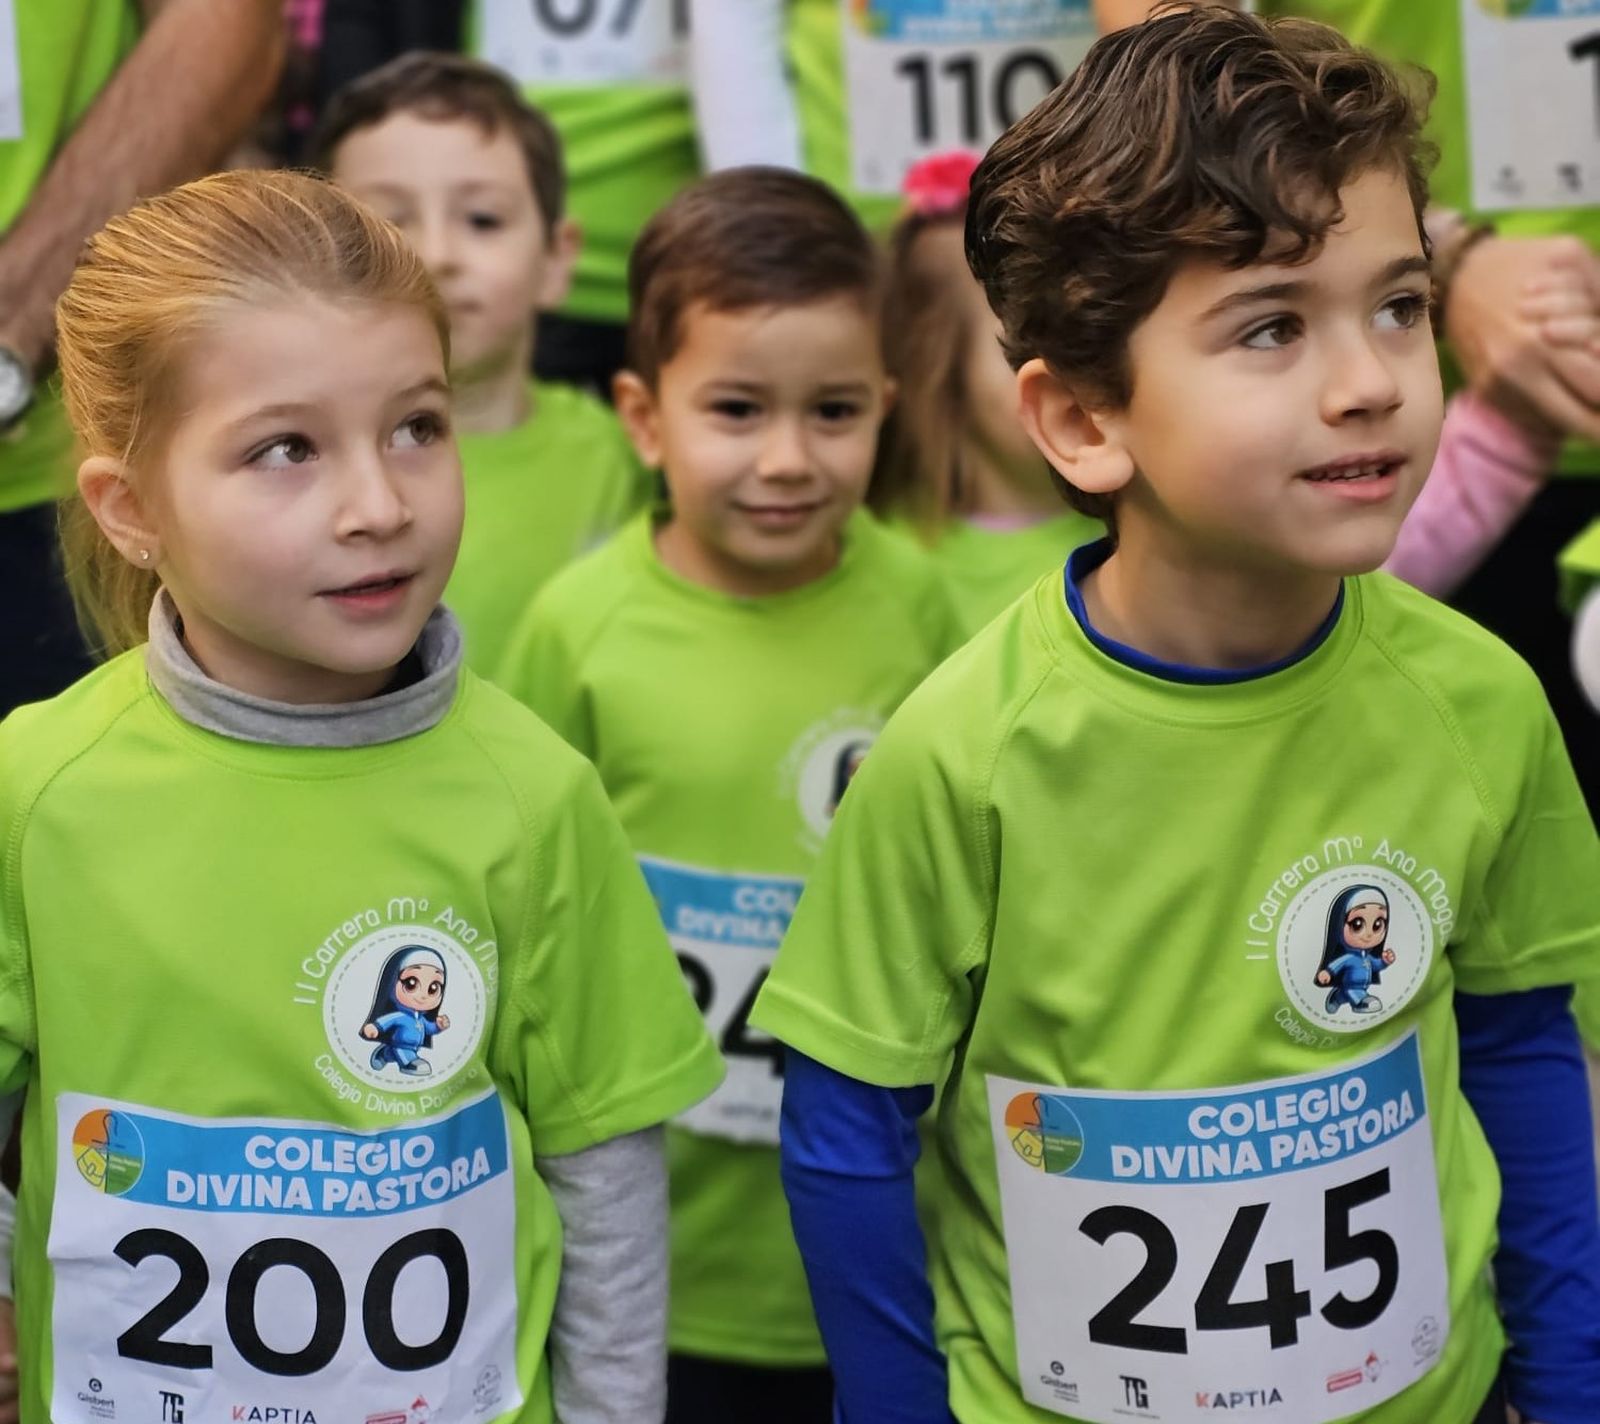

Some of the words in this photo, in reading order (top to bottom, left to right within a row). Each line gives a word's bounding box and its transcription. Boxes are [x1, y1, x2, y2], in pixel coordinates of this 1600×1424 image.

[1248, 854, 1321, 933] Carrera
[1371, 839, 1417, 876] Ana
[302, 908, 381, 979] Carrera
[433, 905, 479, 945] Ana
[315, 1054, 361, 1104] Colegio
[365, 1092, 416, 1117] Divina
[1188, 1076, 1368, 1139] COLEGIO
[244, 1134, 435, 1174] COLEGIO
[1110, 1136, 1263, 1178] DIVINA
[1270, 1090, 1416, 1168] PASTORA
[166, 1170, 315, 1211] DIVINA
[322, 1146, 491, 1212] PASTORA
[1078, 1166, 1400, 1356] 245
[113, 1226, 471, 1377] 200
[232, 1406, 317, 1424] KAPTIA
[1194, 1387, 1284, 1410] KAPTIA
